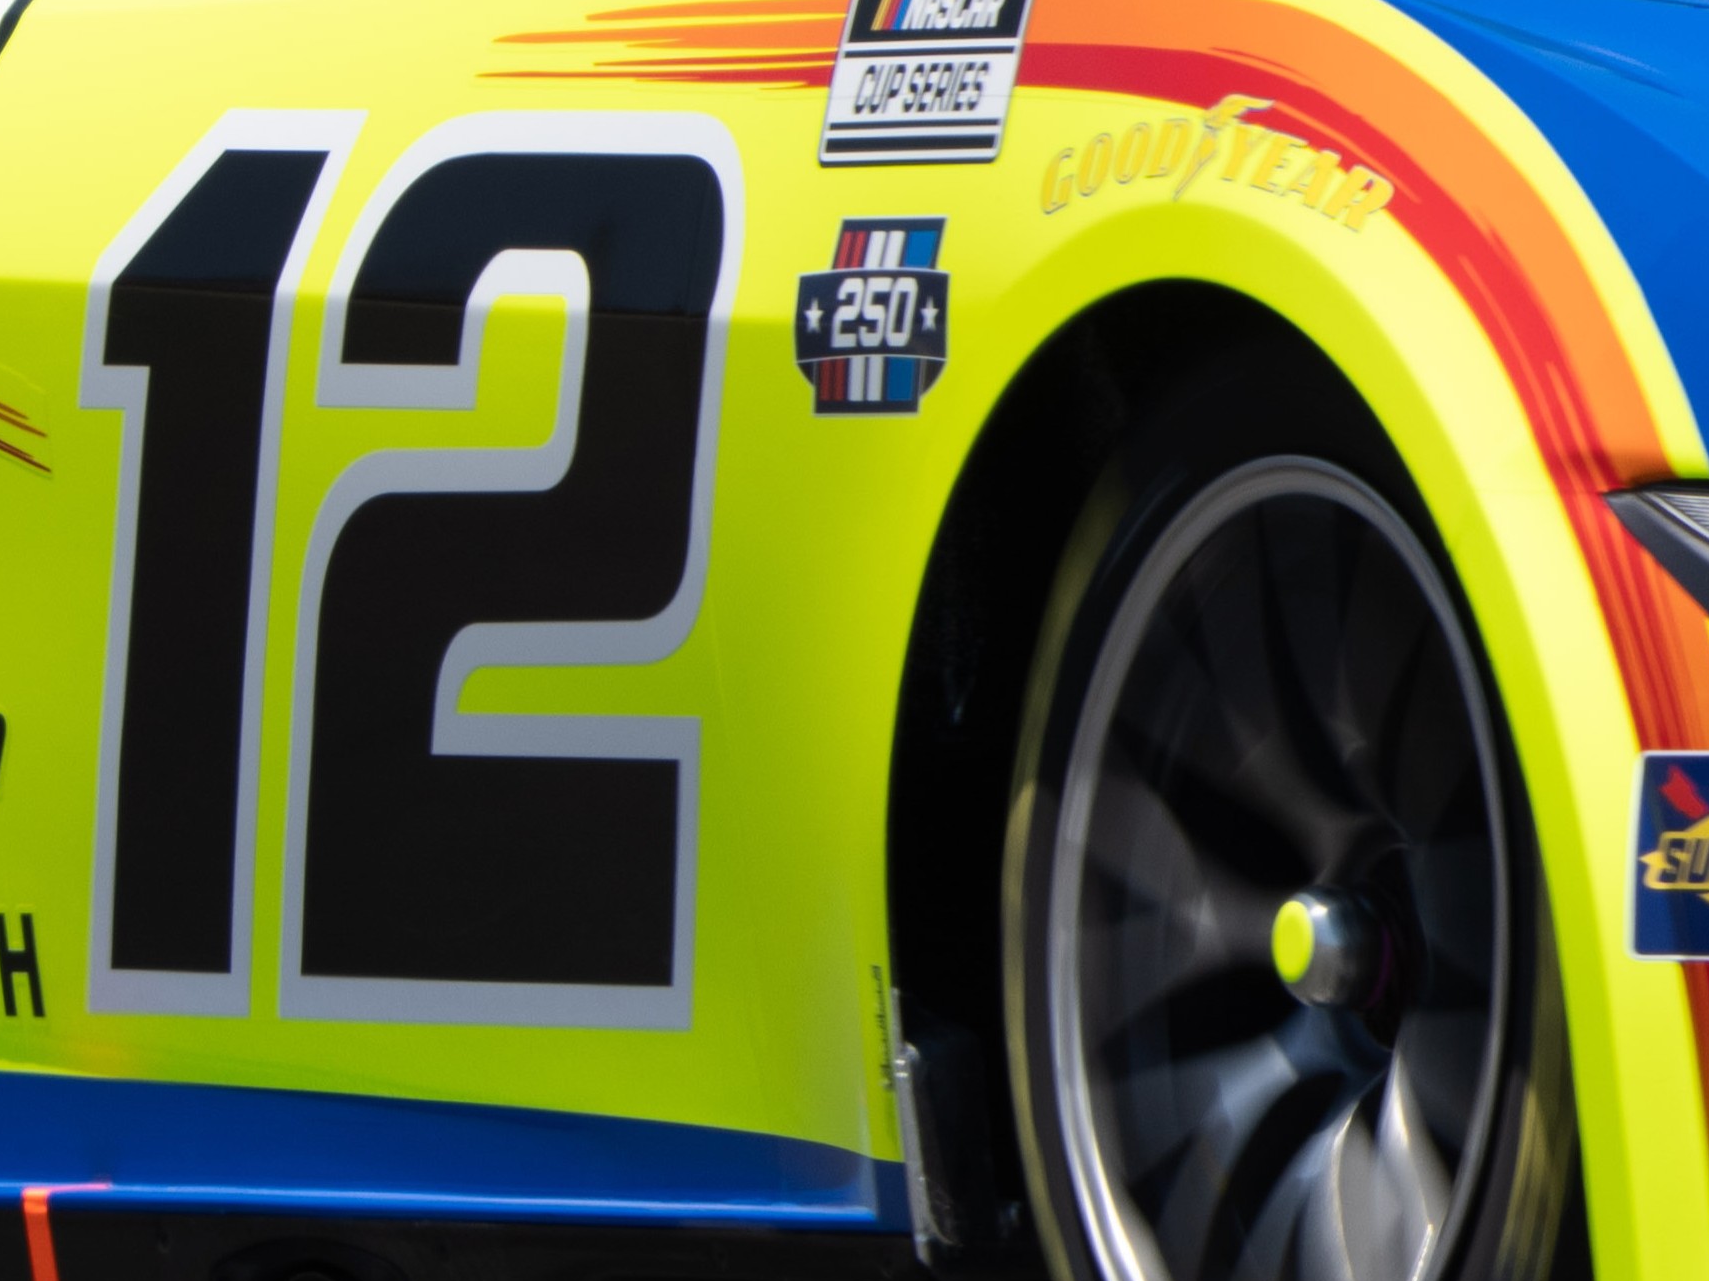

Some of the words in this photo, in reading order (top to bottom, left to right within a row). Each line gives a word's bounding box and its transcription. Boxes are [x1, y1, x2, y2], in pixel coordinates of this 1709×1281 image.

[854, 63, 907, 115] CUP
[903, 61, 990, 113] SERIES
[1041, 106, 1395, 232] GOODYEAR
[831, 276, 918, 349] 250
[81, 109, 745, 1031] 12
